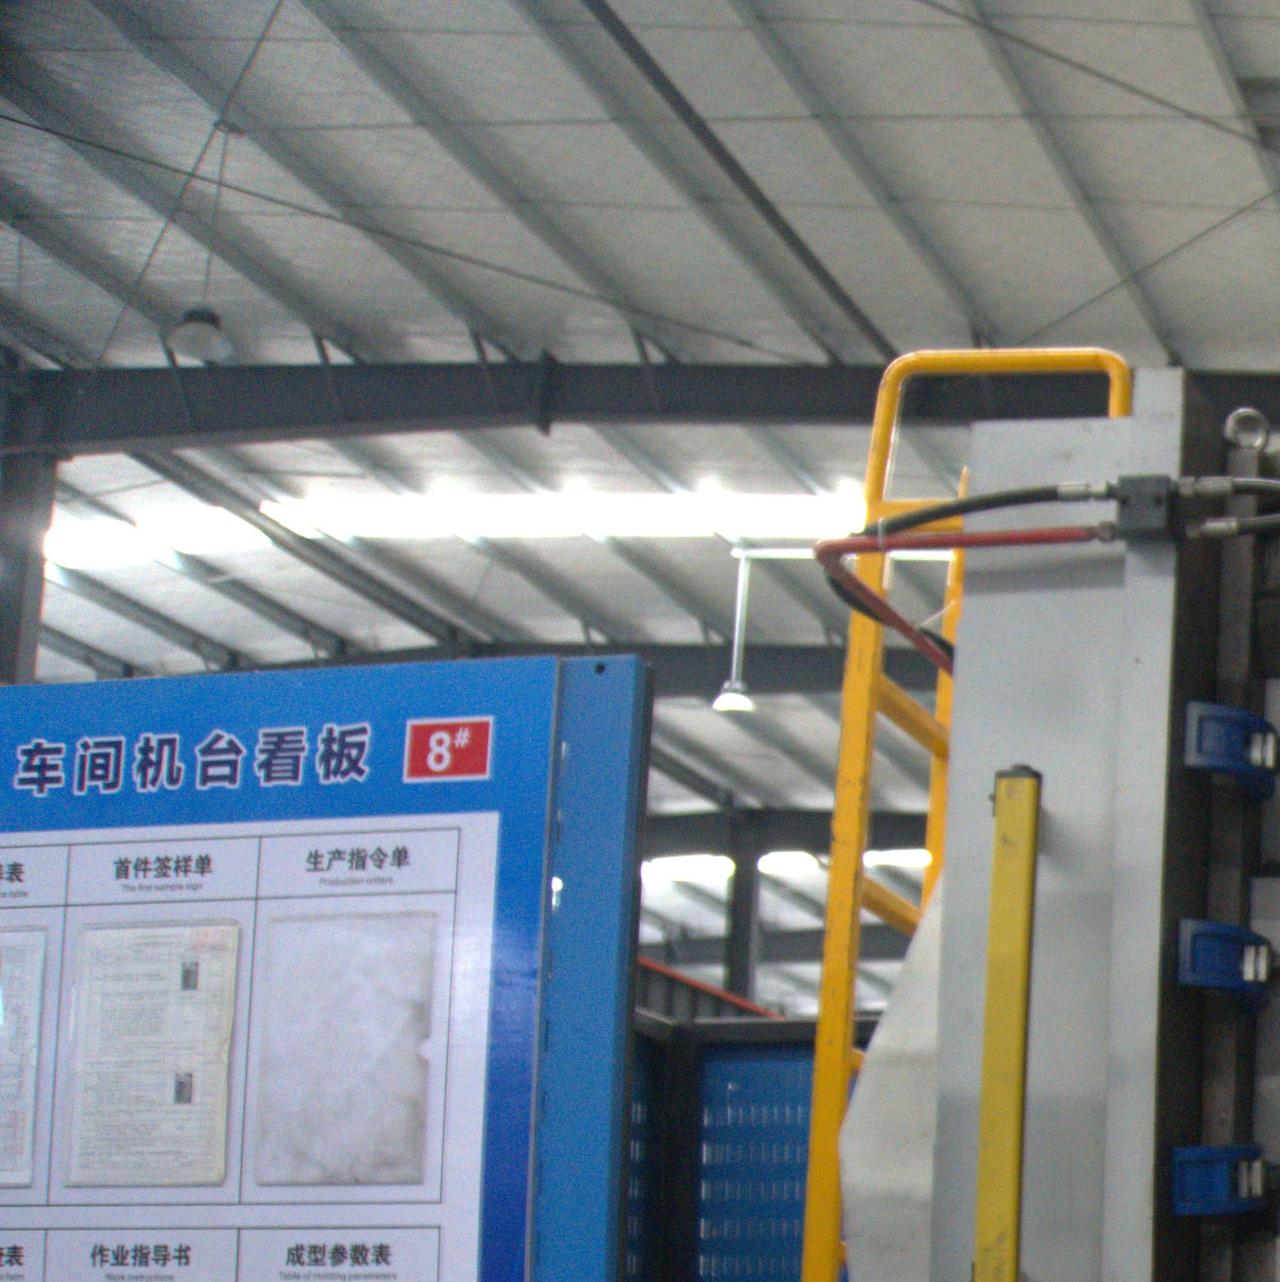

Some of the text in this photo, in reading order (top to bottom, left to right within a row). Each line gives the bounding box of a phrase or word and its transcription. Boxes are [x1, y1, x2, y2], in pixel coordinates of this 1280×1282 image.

[15, 721, 370, 796] 车间机台看板
[426, 727, 470, 771] 8#
[114, 853, 213, 879] 首件签样单
[305, 846, 409, 872] 生产指令单
[0, 862, 24, 883] 表
[0, 1244, 24, 1267] 表
[91, 1244, 191, 1267] 作业指导书
[285, 1243, 391, 1267] 成型参数表
